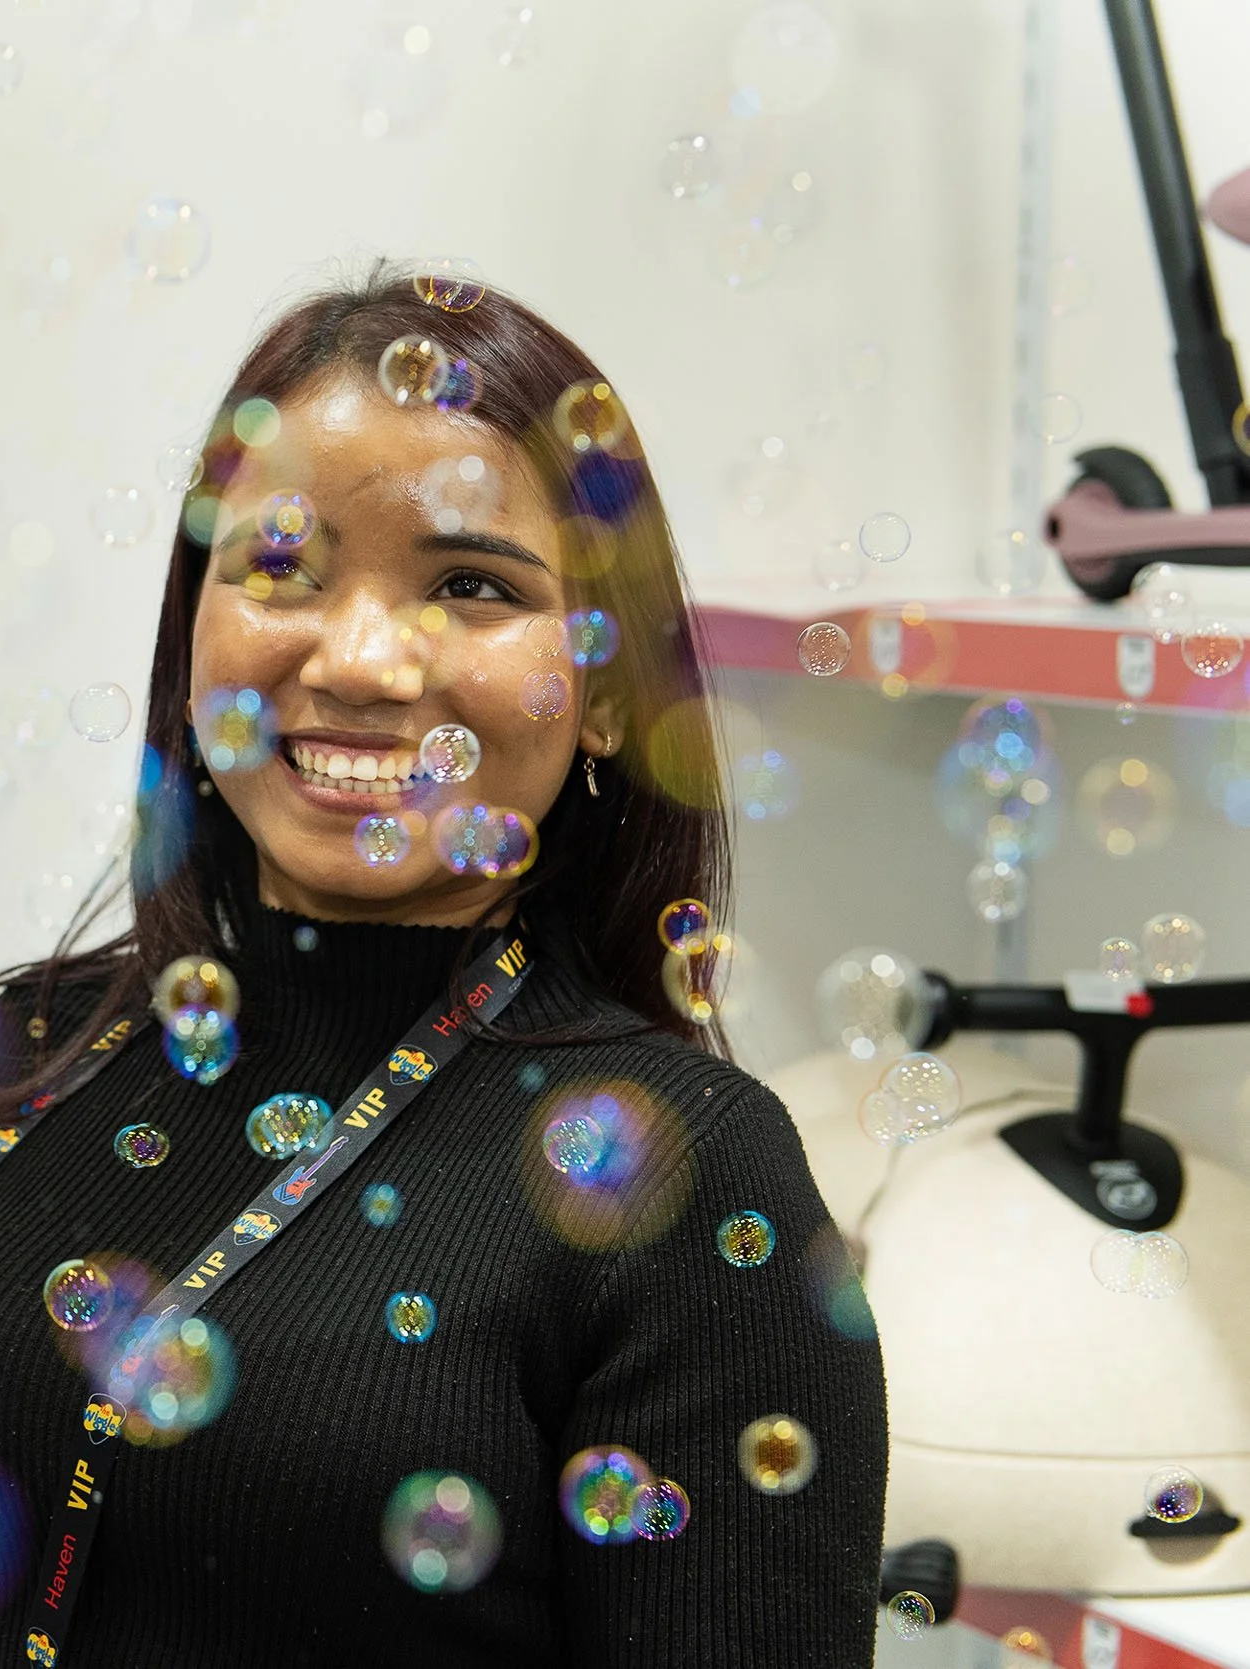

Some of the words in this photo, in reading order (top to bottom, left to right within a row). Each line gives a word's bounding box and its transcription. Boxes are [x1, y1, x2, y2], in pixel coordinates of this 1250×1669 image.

[495, 938, 527, 978] VIP
[432, 983, 494, 1037] Haen
[343, 1087, 388, 1129] VIP
[182, 1250, 228, 1290] VIP
[83, 1408, 122, 1439] Wiggles
[67, 1459, 95, 1511] VIP
[44, 1534, 77, 1610] Haven
